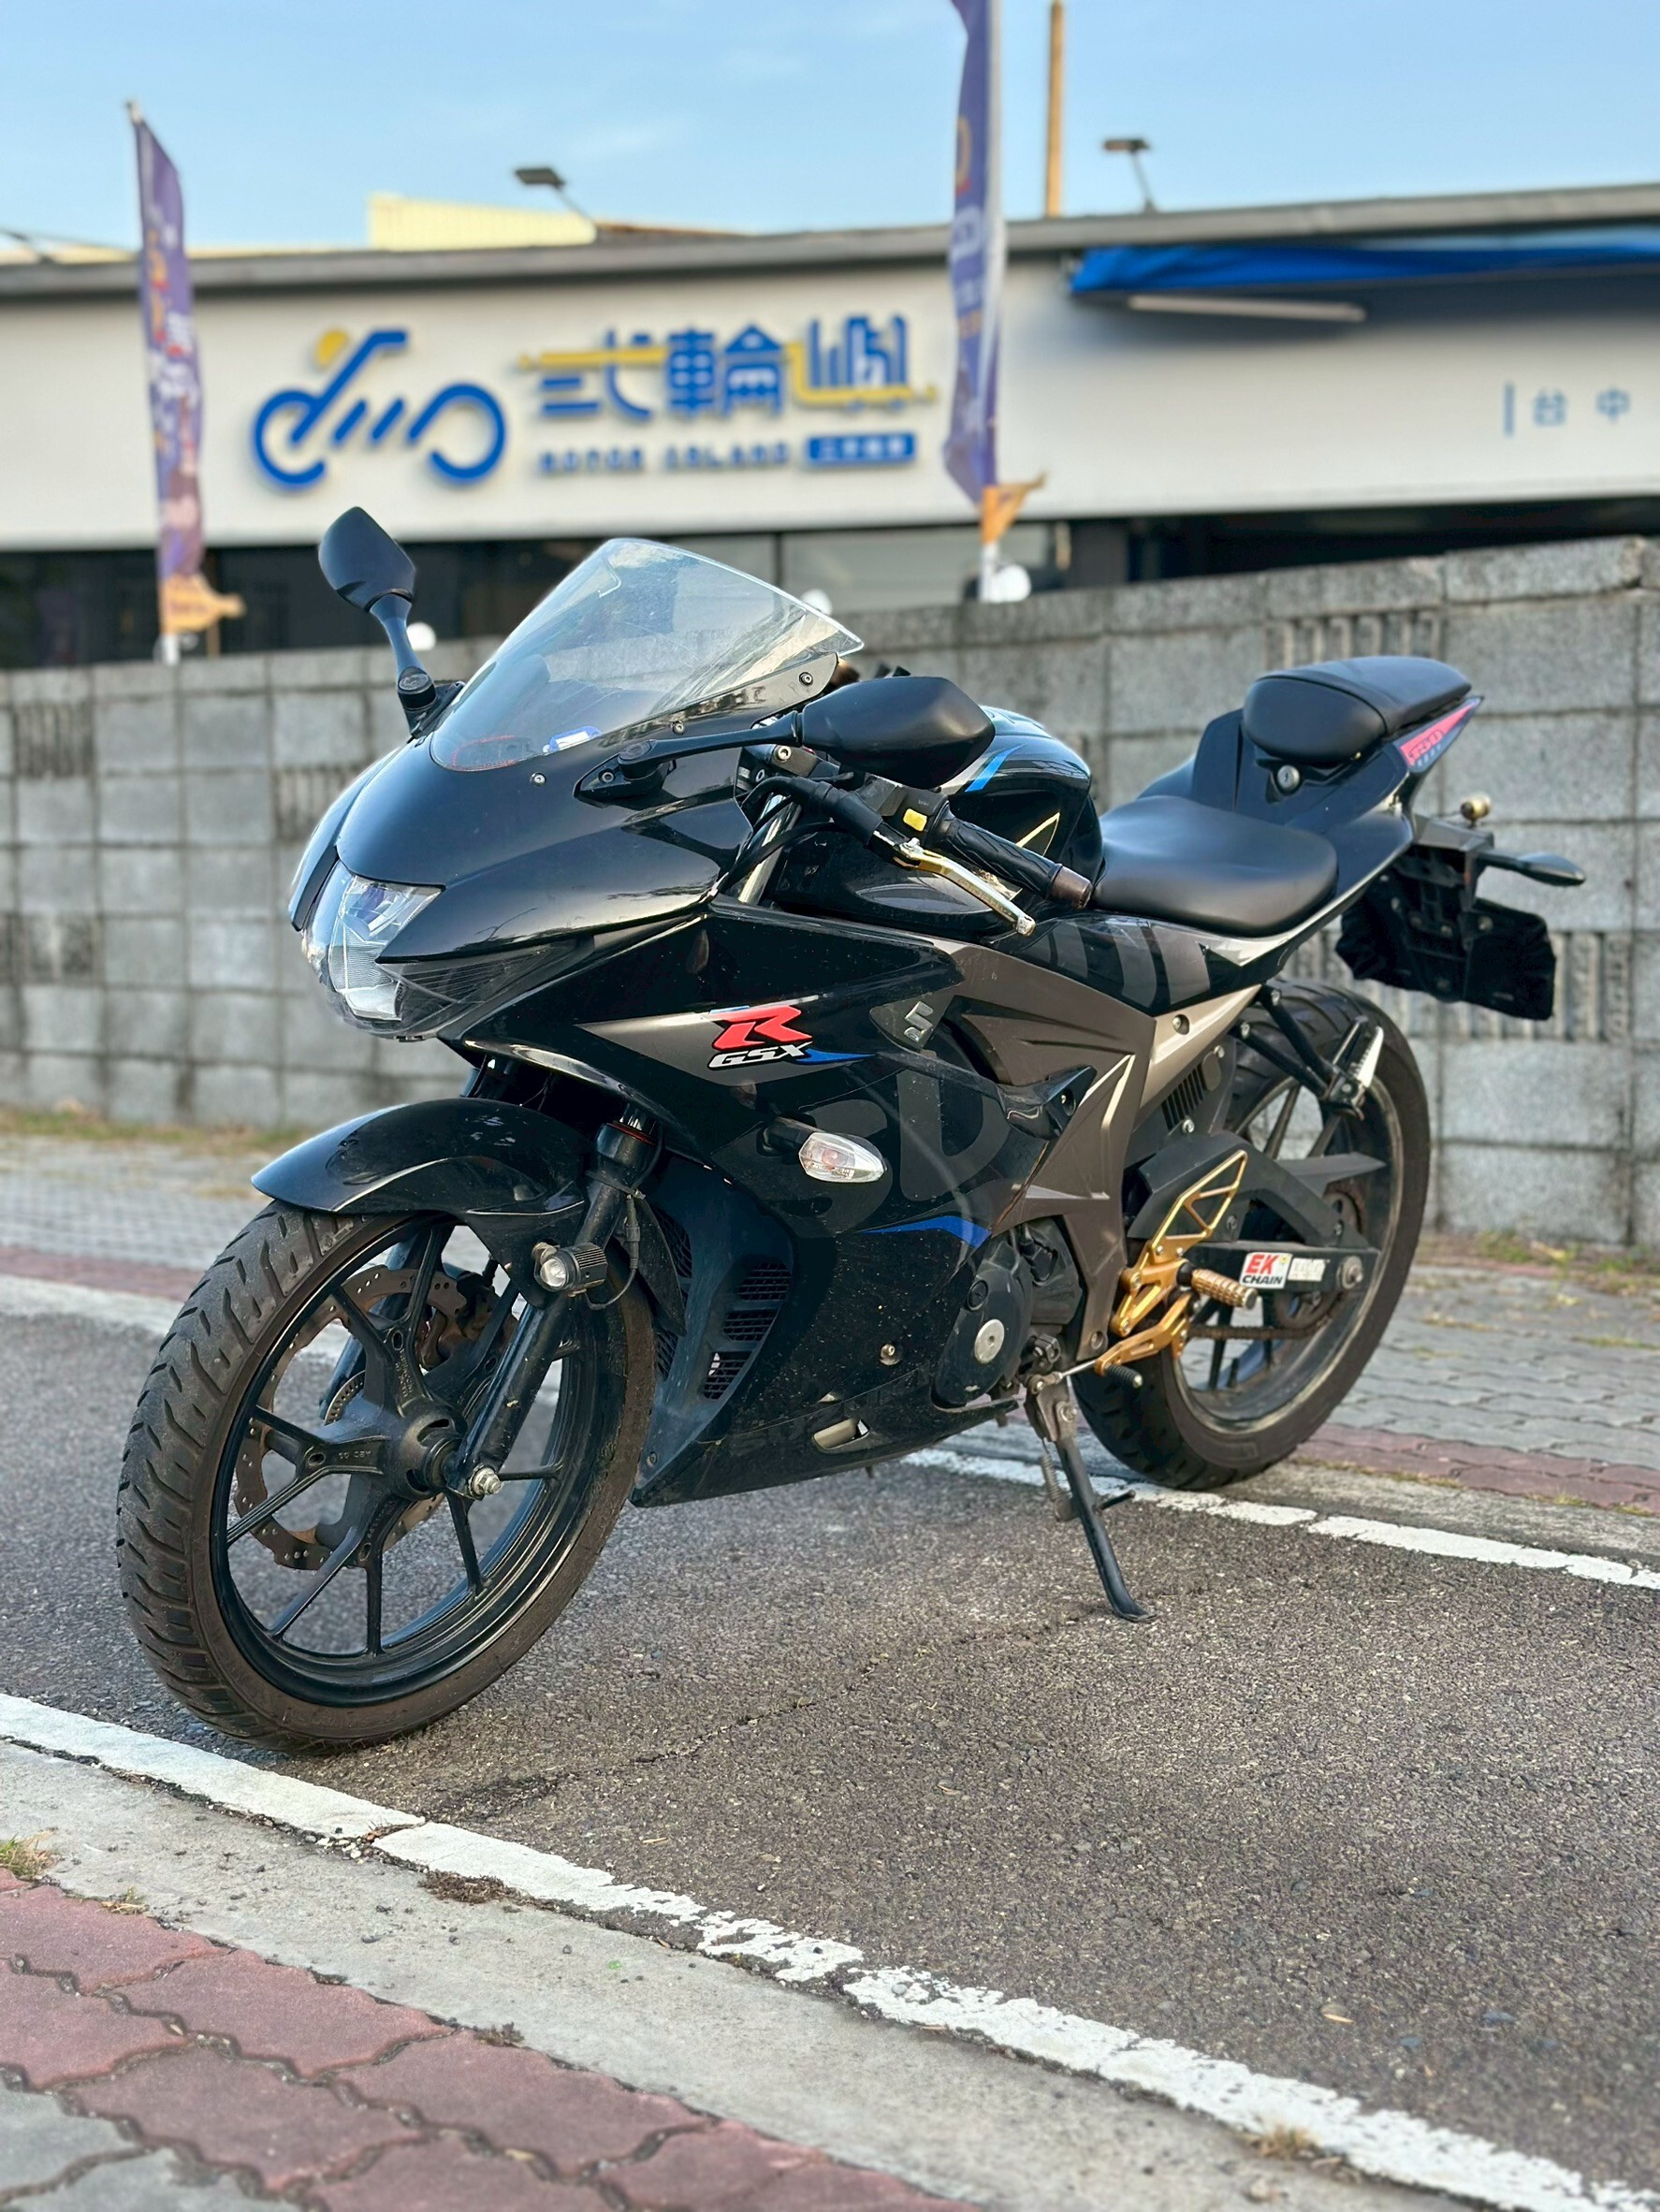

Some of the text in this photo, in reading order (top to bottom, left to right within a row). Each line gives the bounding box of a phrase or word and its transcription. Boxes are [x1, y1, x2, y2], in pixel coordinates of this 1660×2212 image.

[714, 1004, 813, 1050] R
[709, 1042, 812, 1069] GSX
[1245, 1254, 1278, 1274] EK
[1242, 1274, 1283, 1286] CHAIN
